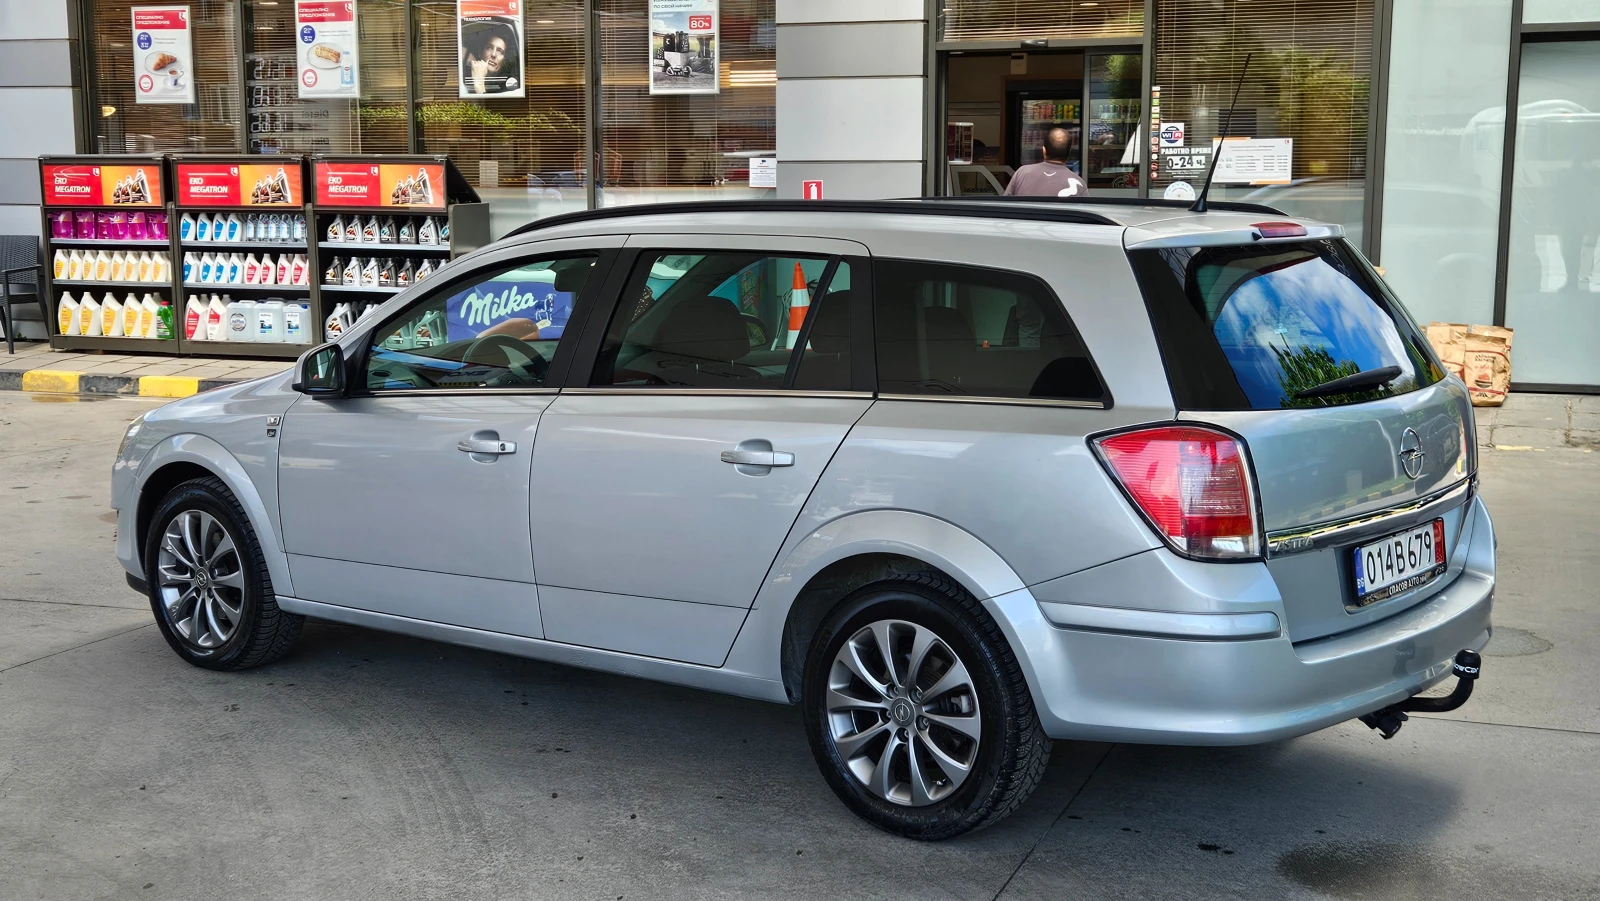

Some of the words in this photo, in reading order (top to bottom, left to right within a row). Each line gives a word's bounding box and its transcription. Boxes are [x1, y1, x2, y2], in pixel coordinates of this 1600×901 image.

[691, 20, 710, 28] 80%
[1167, 157, 1194, 169] 0-24
[54, 177, 67, 185] EKO
[189, 177, 204, 185] EKO
[327, 176, 342, 184] EKO
[54, 185, 91, 193] MEGATRON
[189, 185, 229, 193] MEGATRON
[328, 185, 368, 193] MEGATRON
[460, 285, 538, 326] Milka
[1275, 536, 1314, 552] ASTRA
[1388, 580, 1408, 596] СПАСОВ
